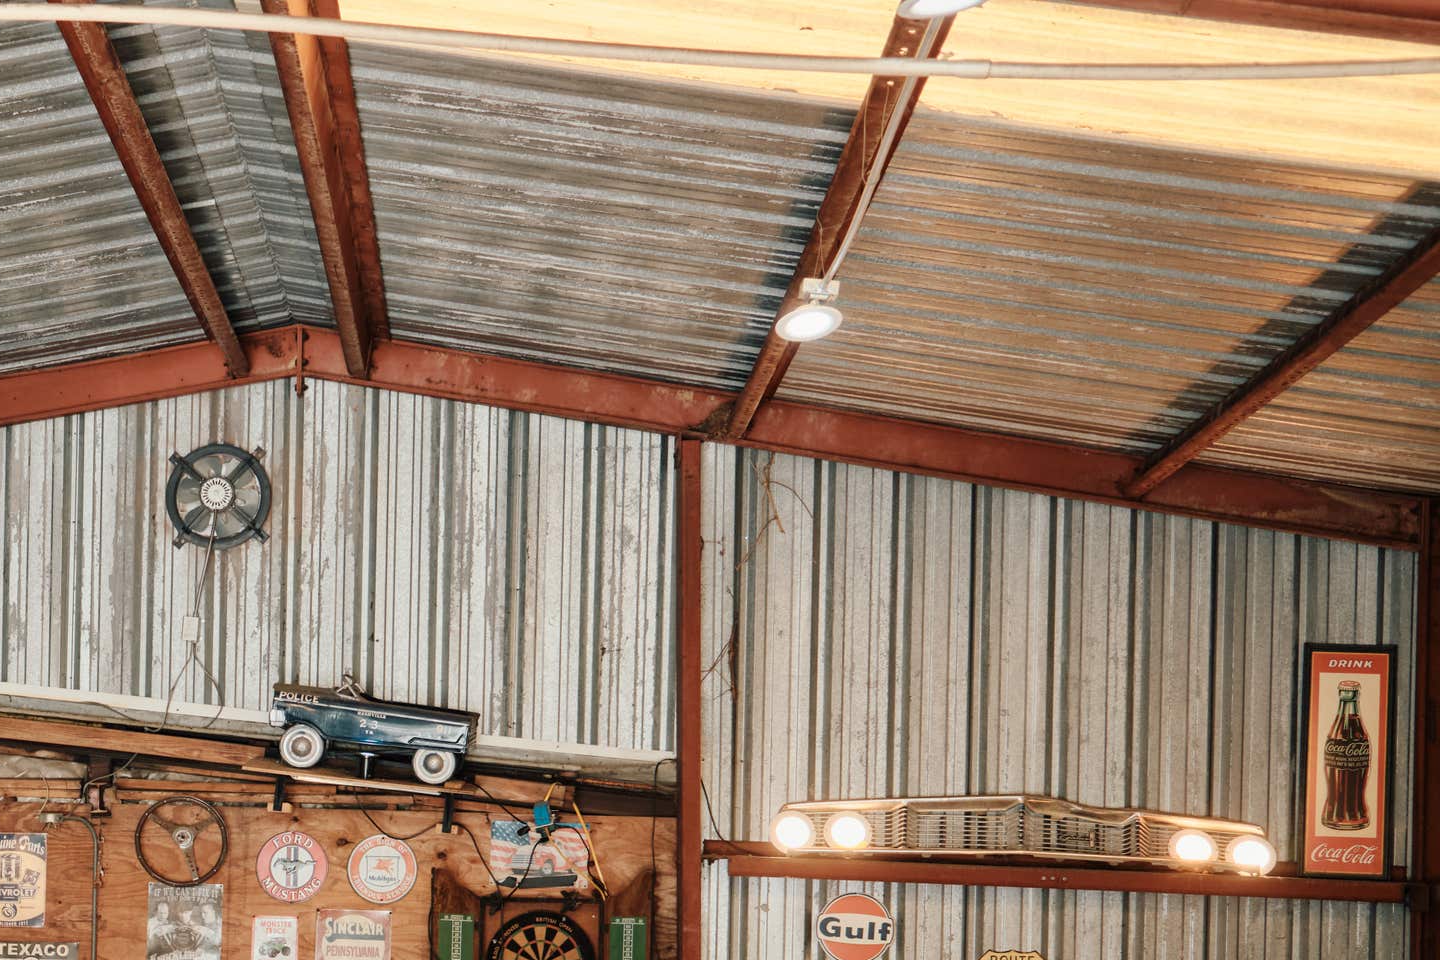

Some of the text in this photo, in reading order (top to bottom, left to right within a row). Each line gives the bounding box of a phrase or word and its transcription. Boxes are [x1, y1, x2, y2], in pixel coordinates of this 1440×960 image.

[1328, 659, 1374, 669] DRINK
[279, 691, 320, 703] POLICE
[1325, 741, 1369, 757] Coca-Cola
[272, 834, 313, 849] FORD
[1310, 842, 1377, 864] Coca-Cola
[262, 876, 321, 900] MUSTANG
[325, 917, 385, 936] SINCLAIR
[818, 916, 892, 943] Gulf
[326, 945, 380, 958] PENNSYLVANIA
